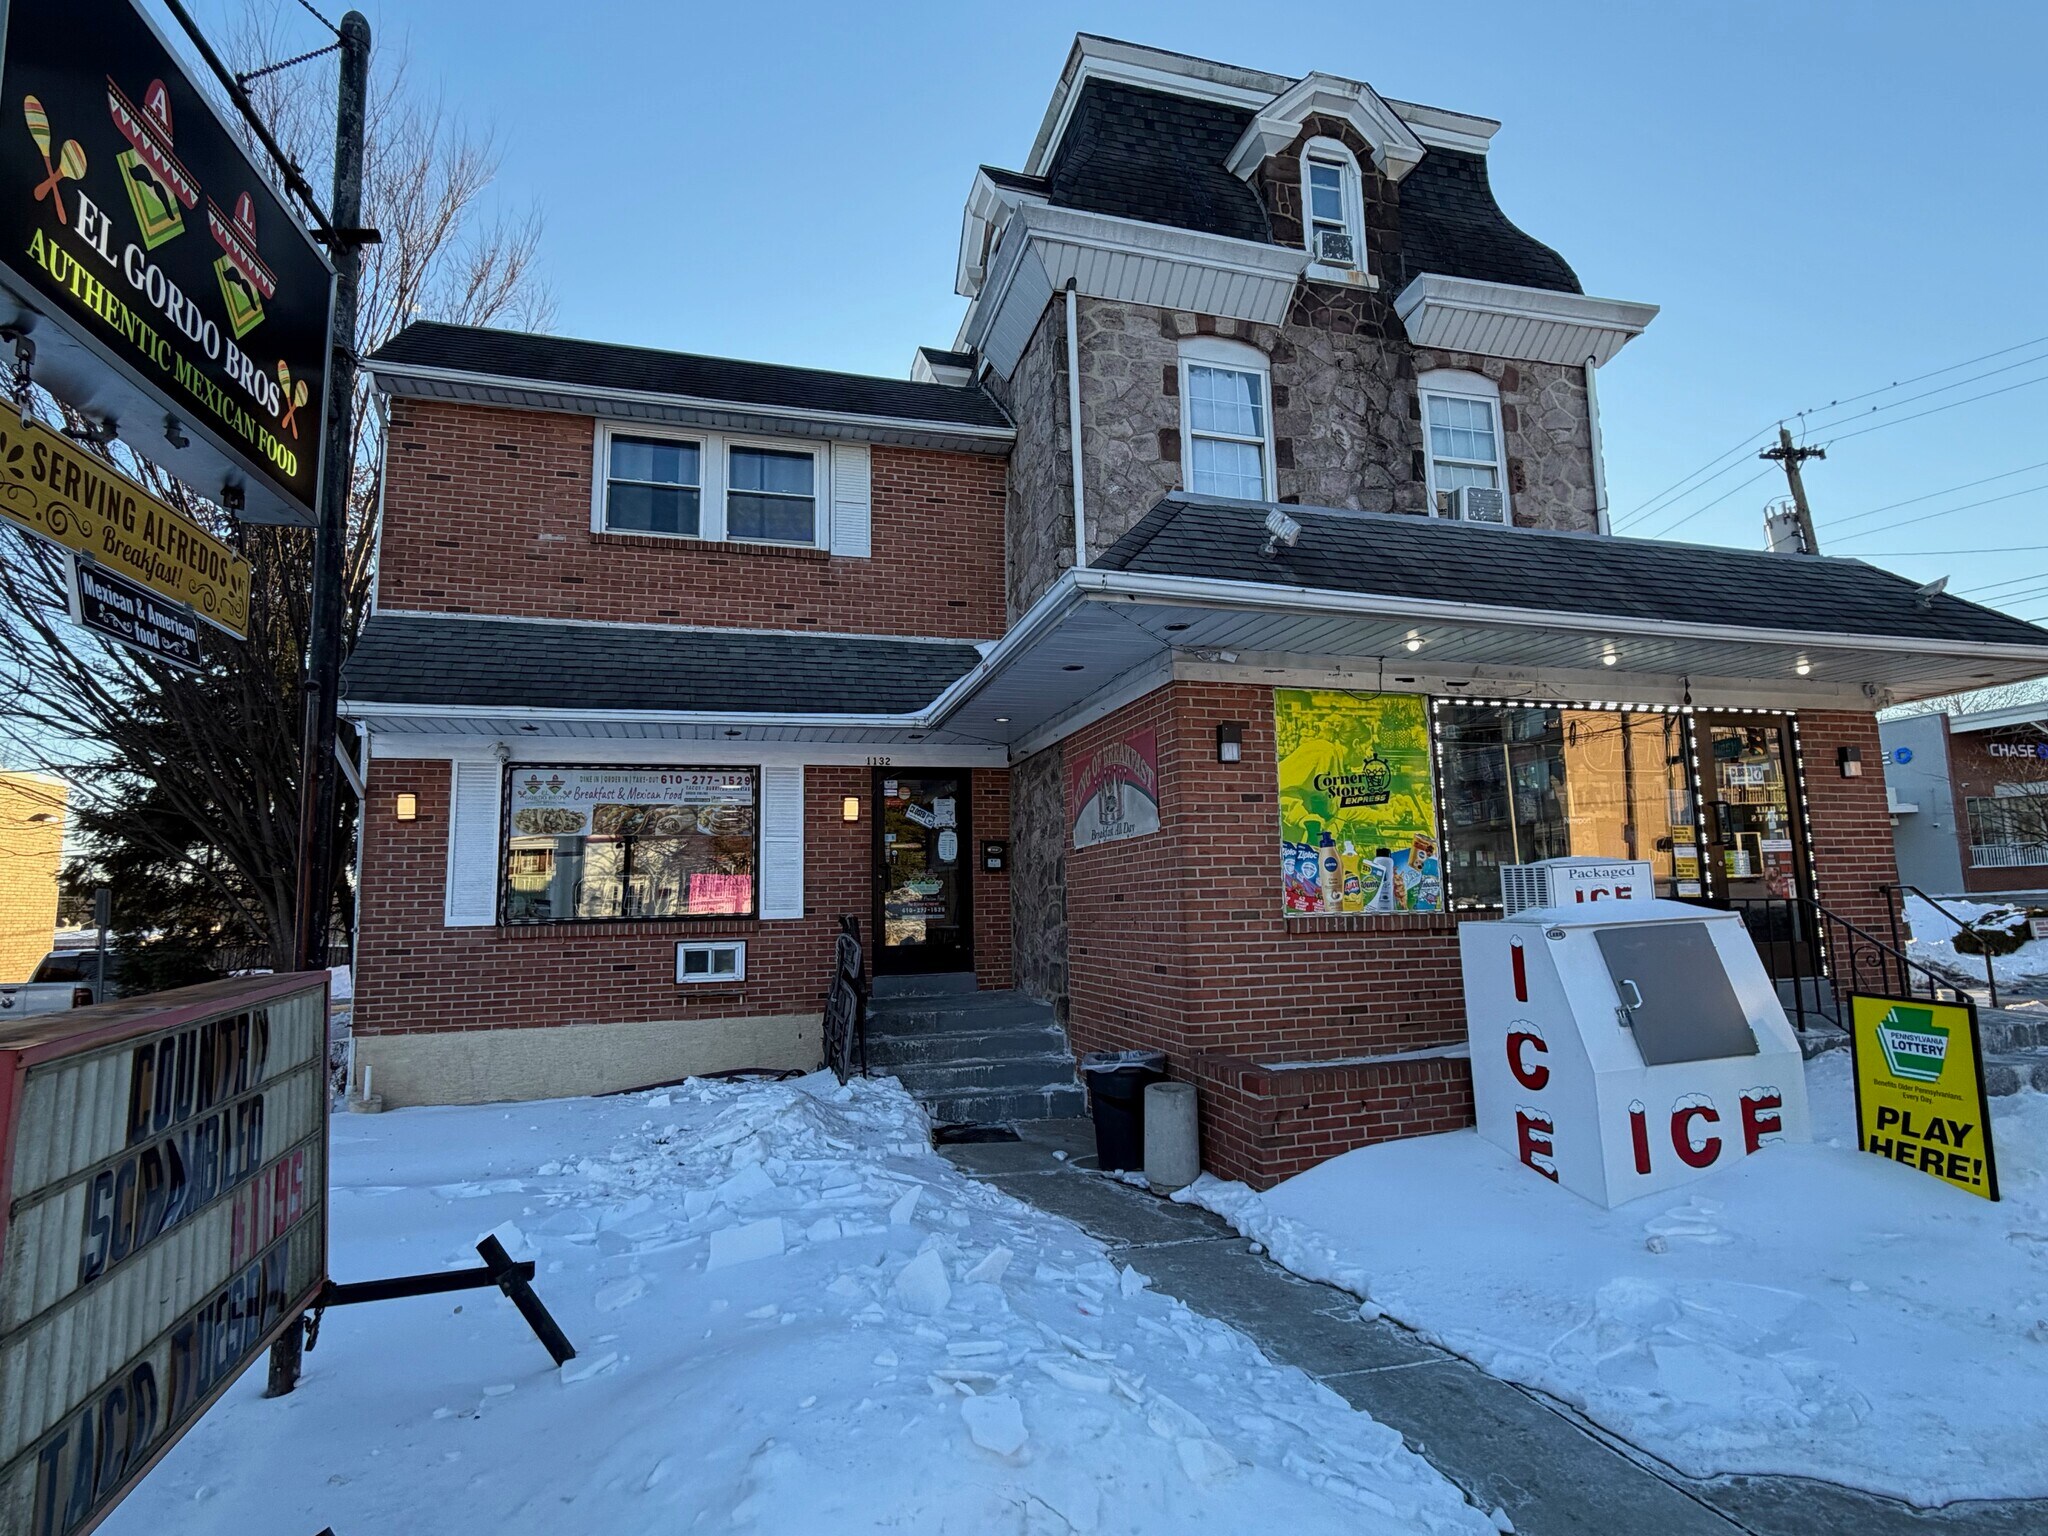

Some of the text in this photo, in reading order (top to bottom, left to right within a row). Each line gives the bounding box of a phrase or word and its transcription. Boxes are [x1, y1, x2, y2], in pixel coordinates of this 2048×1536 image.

[148, 87, 169, 128] A
[74, 190, 281, 419] EL GORDO BROS
[25, 227, 298, 478] AUTHENTIC MEXICAN FOOD
[31, 441, 229, 588] SERVING ALFREDOS
[102, 525, 184, 590] Breakfast!
[82, 571, 197, 644] Mexican & American
[134, 622, 161, 650] food
[866, 756, 891, 766] 1132
[1989, 743, 2037, 758] CHASE
[660, 774, 751, 786] 610-277-1529
[1074, 765, 1091, 809] KING
[1103, 742, 1155, 791] BREAKFAST
[1313, 771, 1366, 792] Corner
[573, 786, 684, 801] Breakfast & Mexican Food
[1328, 785, 1366, 799] Store
[1345, 794, 1388, 805] EXPRESS
[1297, 850, 1319, 861] Ziploc
[1568, 865, 1636, 880] Packaged
[1574, 883, 1633, 903] ICE
[1890, 1031, 1945, 1045] PENNSYLVANIA
[1891, 1040, 1945, 1057] LOTTERY
[1506, 935, 1560, 1184] ICE
[131, 1008, 270, 1146] COUNTRY
[1873, 1078, 1964, 1101] Benefits Older Pennsylvanians.
[1902, 1092, 1934, 1105] Every Day.
[1628, 1086, 1786, 1175] ICE
[1876, 1105, 1975, 1149] PLAY
[1869, 1135, 1983, 1186] HERE!
